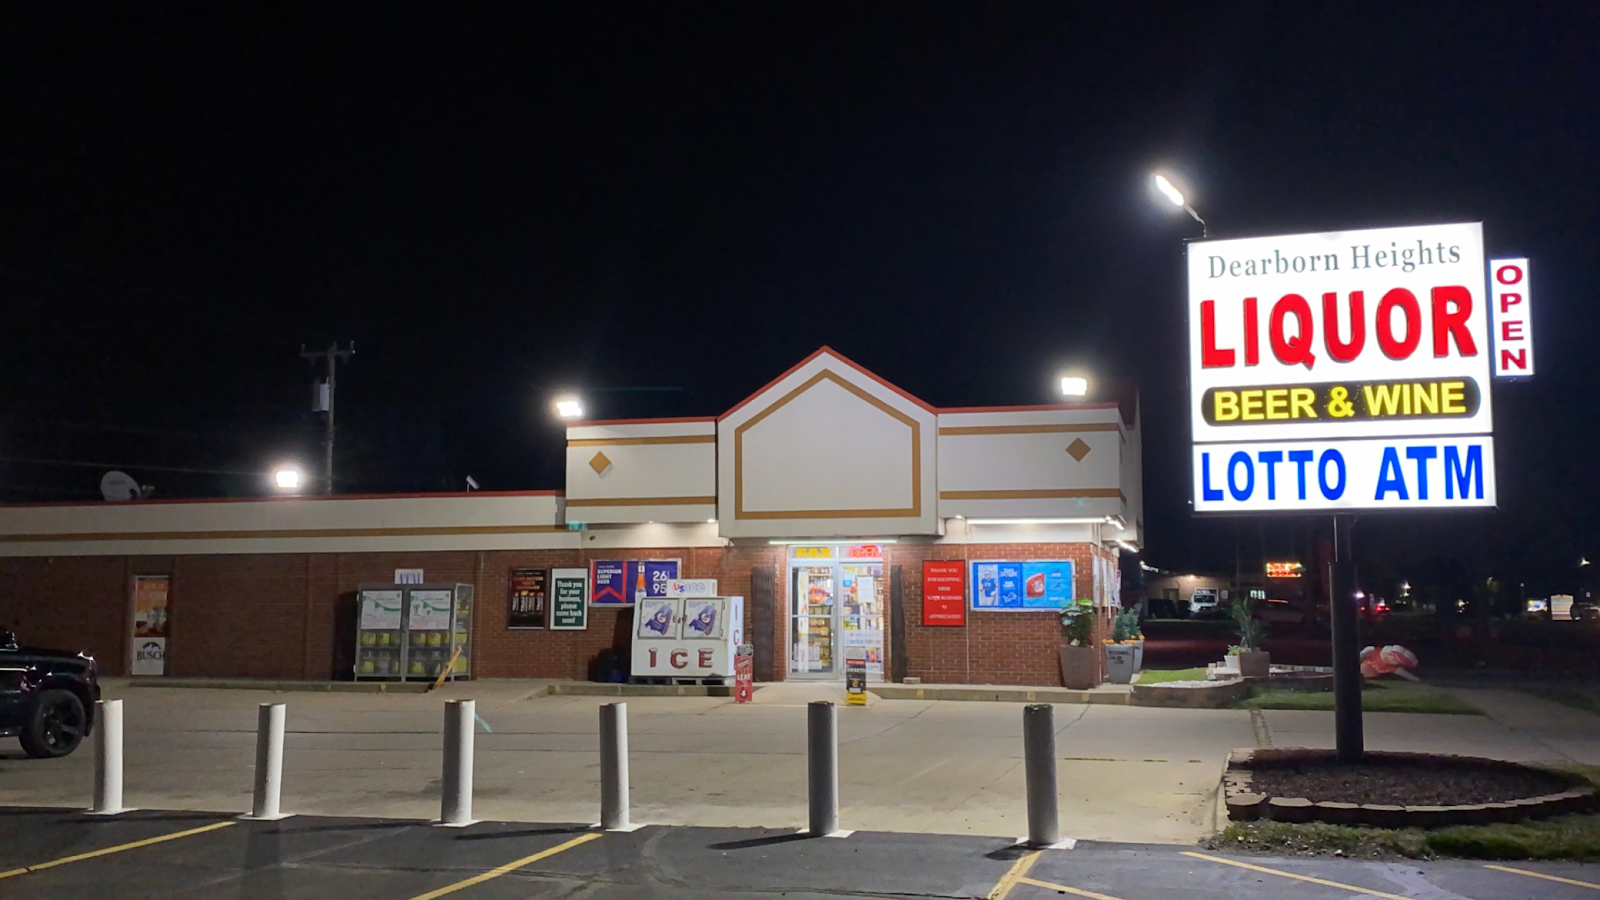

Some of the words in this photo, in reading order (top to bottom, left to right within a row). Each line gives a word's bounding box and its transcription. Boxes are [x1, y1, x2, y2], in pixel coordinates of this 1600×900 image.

[1208, 250, 1340, 279] Dearborn
[1350, 239, 1461, 272] Heights
[1200, 285, 1478, 371] LIQUOR
[1496, 265, 1527, 371] OPEN
[1213, 388, 1318, 421] BEER
[1327, 386, 1355, 418] &
[1364, 381, 1467, 416] WINE
[1201, 448, 1347, 502] LOTTO
[1374, 445, 1485, 500] ATM
[796, 547, 832, 558] FAX
[848, 545, 882, 558] OPEN
[652, 570, 668, 582] 26
[652, 583, 667, 594] 95
[136, 651, 165, 661] BUSCH
[649, 647, 715, 669] ICE
